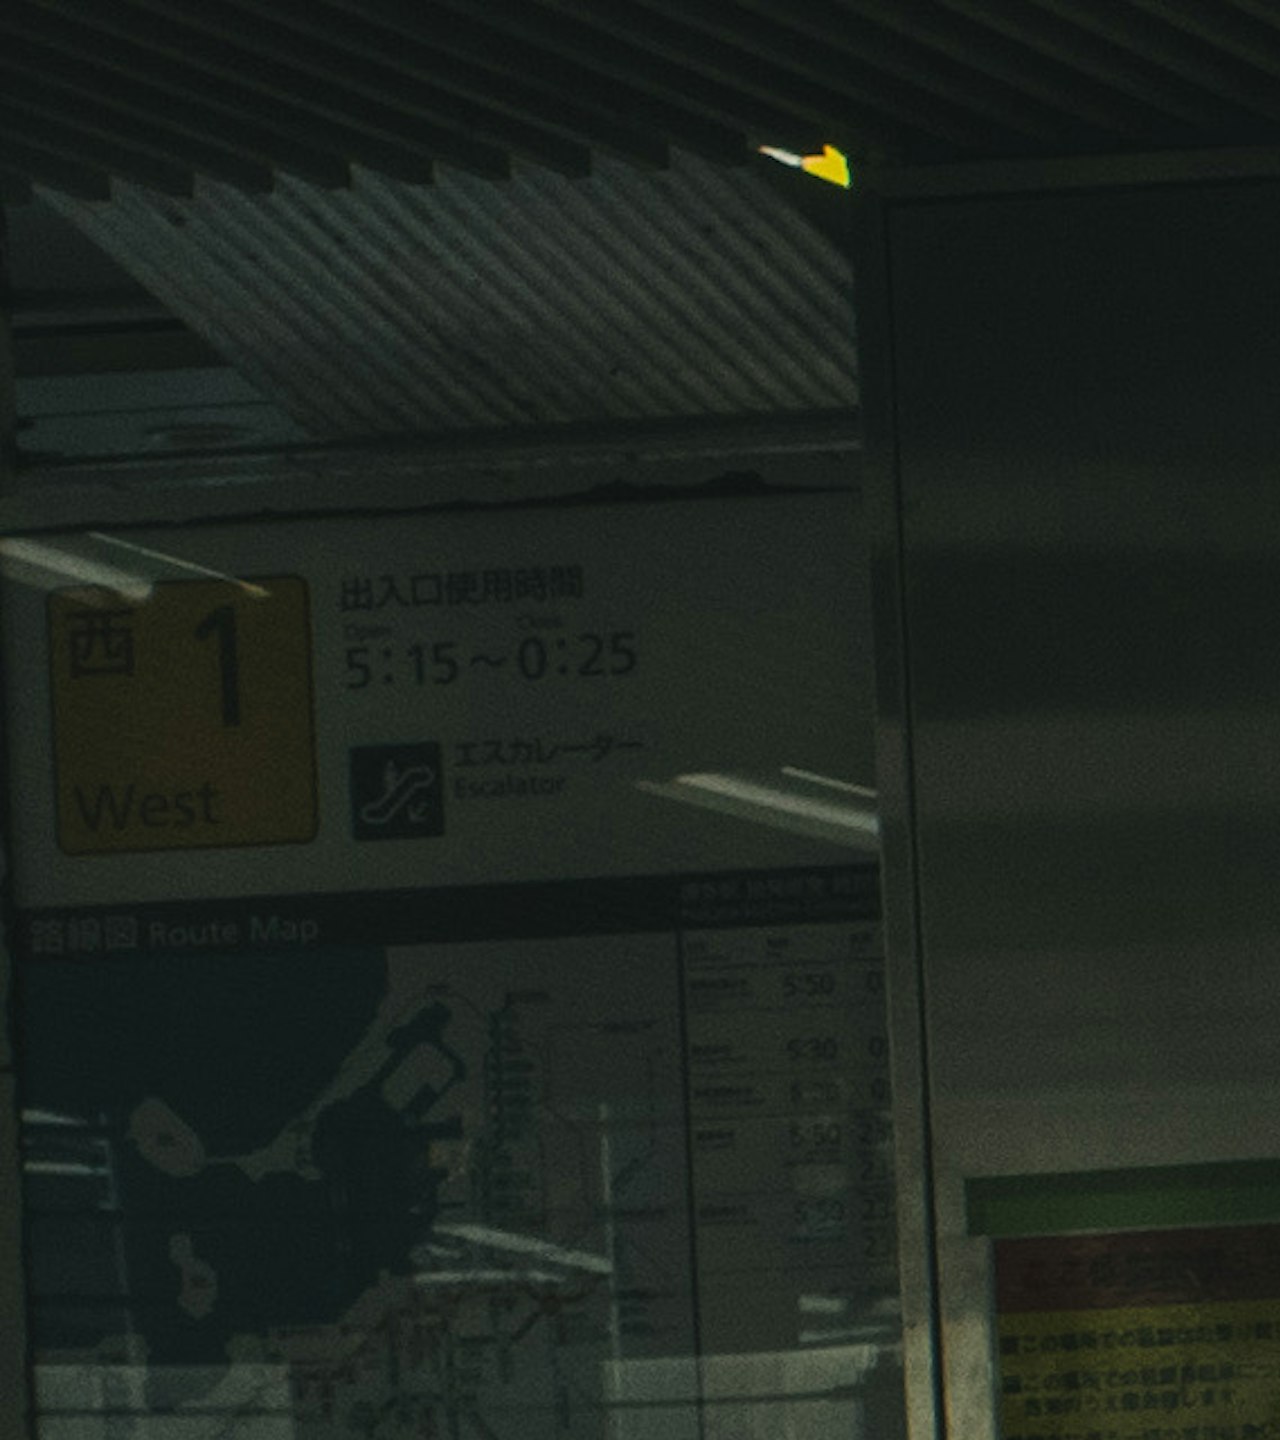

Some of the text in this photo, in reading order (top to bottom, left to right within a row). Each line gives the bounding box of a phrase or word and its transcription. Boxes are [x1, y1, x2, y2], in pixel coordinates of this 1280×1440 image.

[67, 608, 135, 678] 西
[194, 606, 240, 726] 1
[454, 735, 644, 768] エスカレーター
[75, 781, 222, 831] West
[455, 773, 566, 799] Escalator
[150, 919, 241, 947] Route
[250, 912, 319, 945] Map
